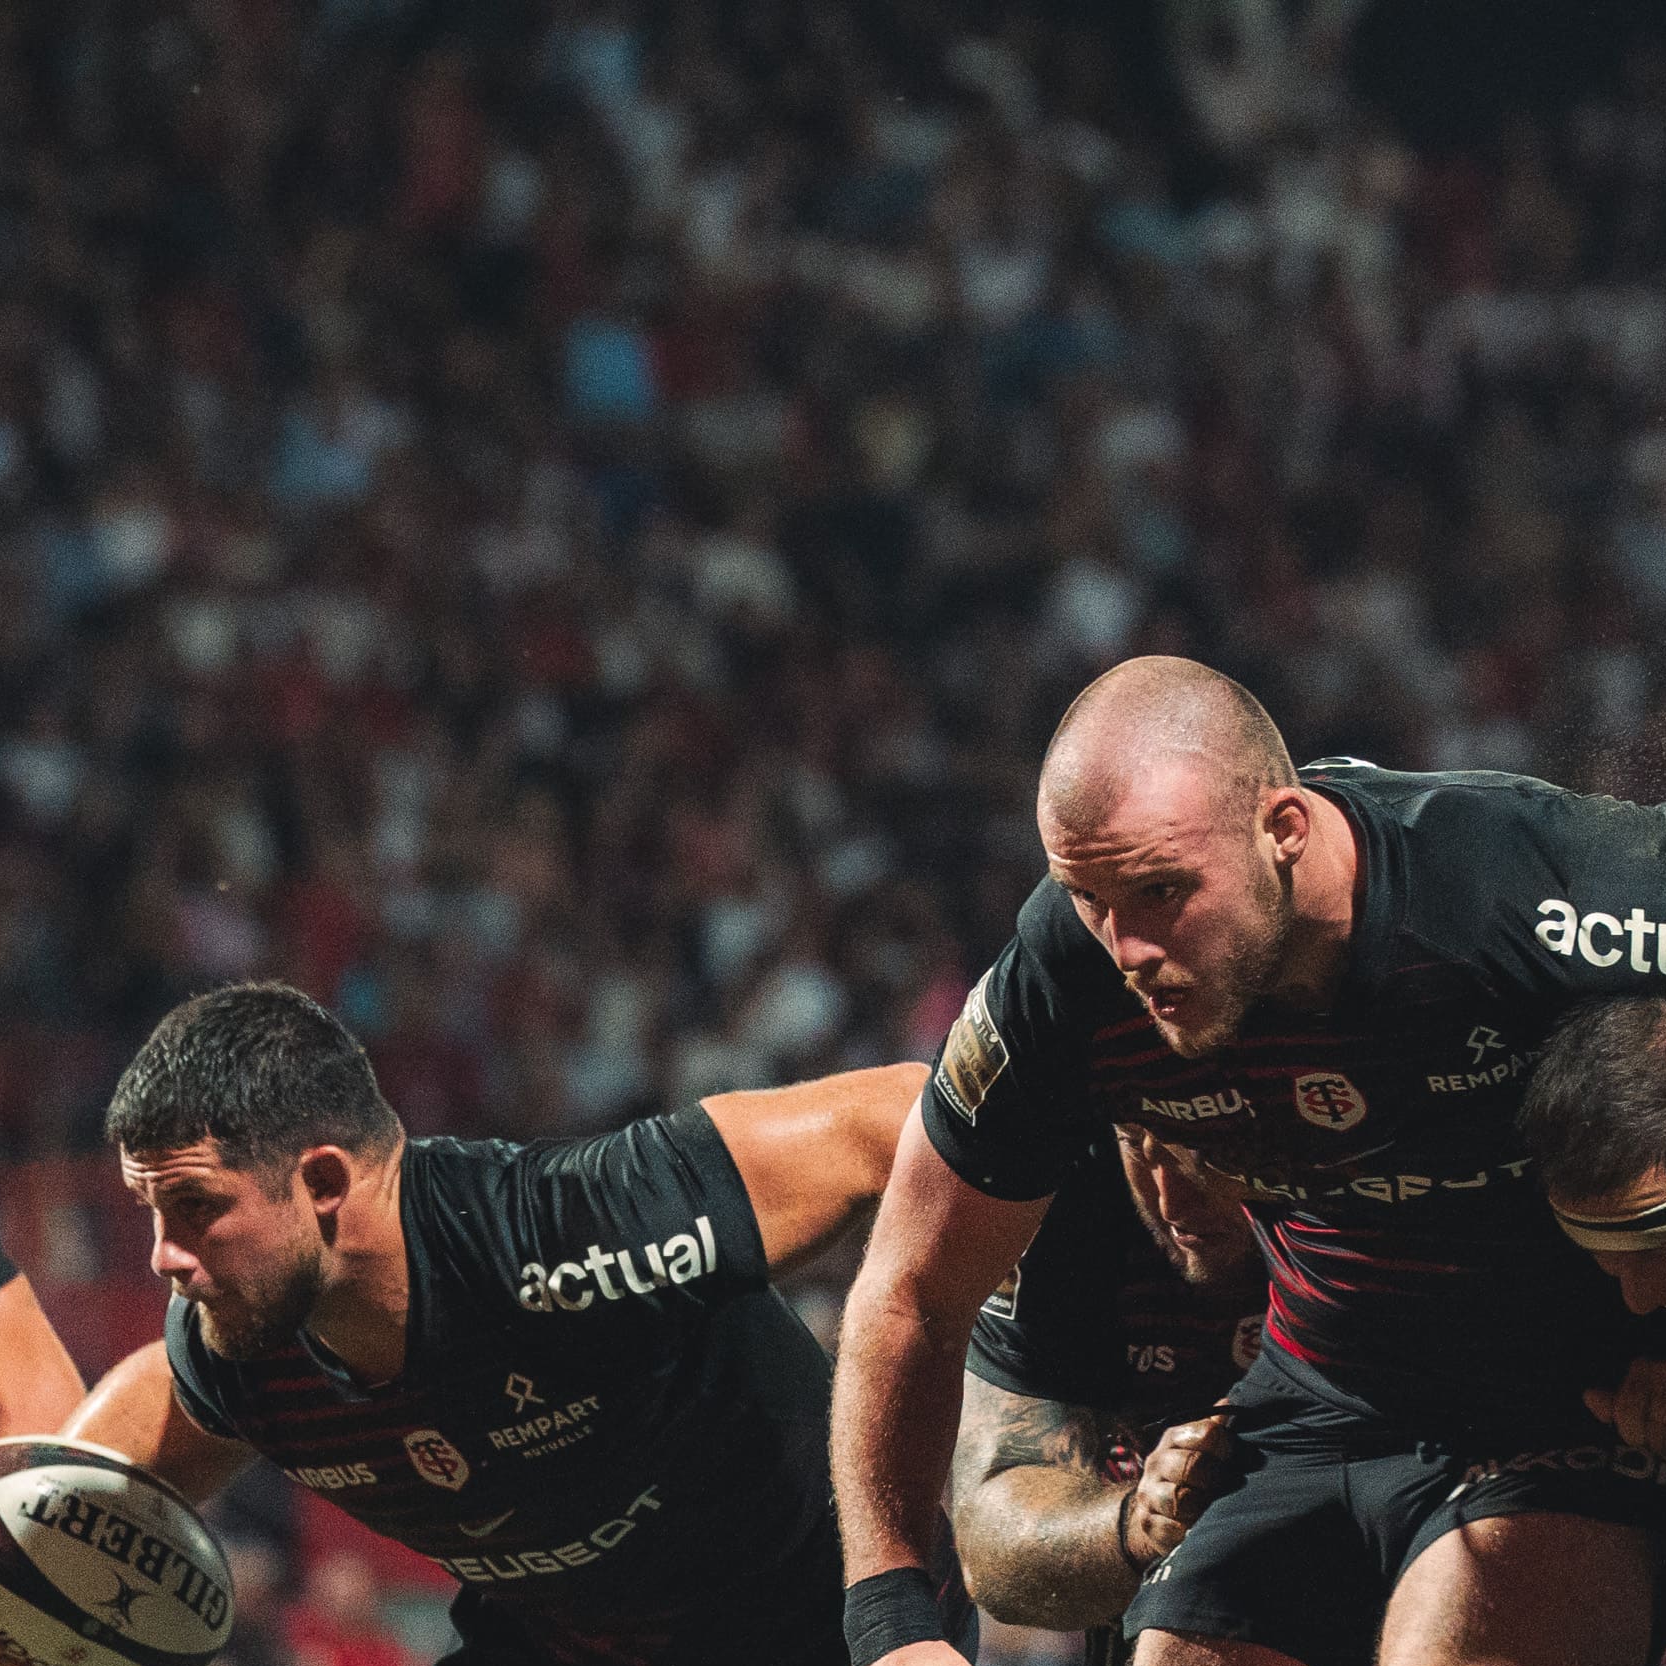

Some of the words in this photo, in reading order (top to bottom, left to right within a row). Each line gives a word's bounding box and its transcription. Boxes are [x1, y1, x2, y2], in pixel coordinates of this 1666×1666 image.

[1427, 1049, 1536, 1094] REMPA
[519, 1216, 718, 1312] actual
[488, 1395, 601, 1452] REMPART
[18, 1493, 228, 1632] GILBERT
